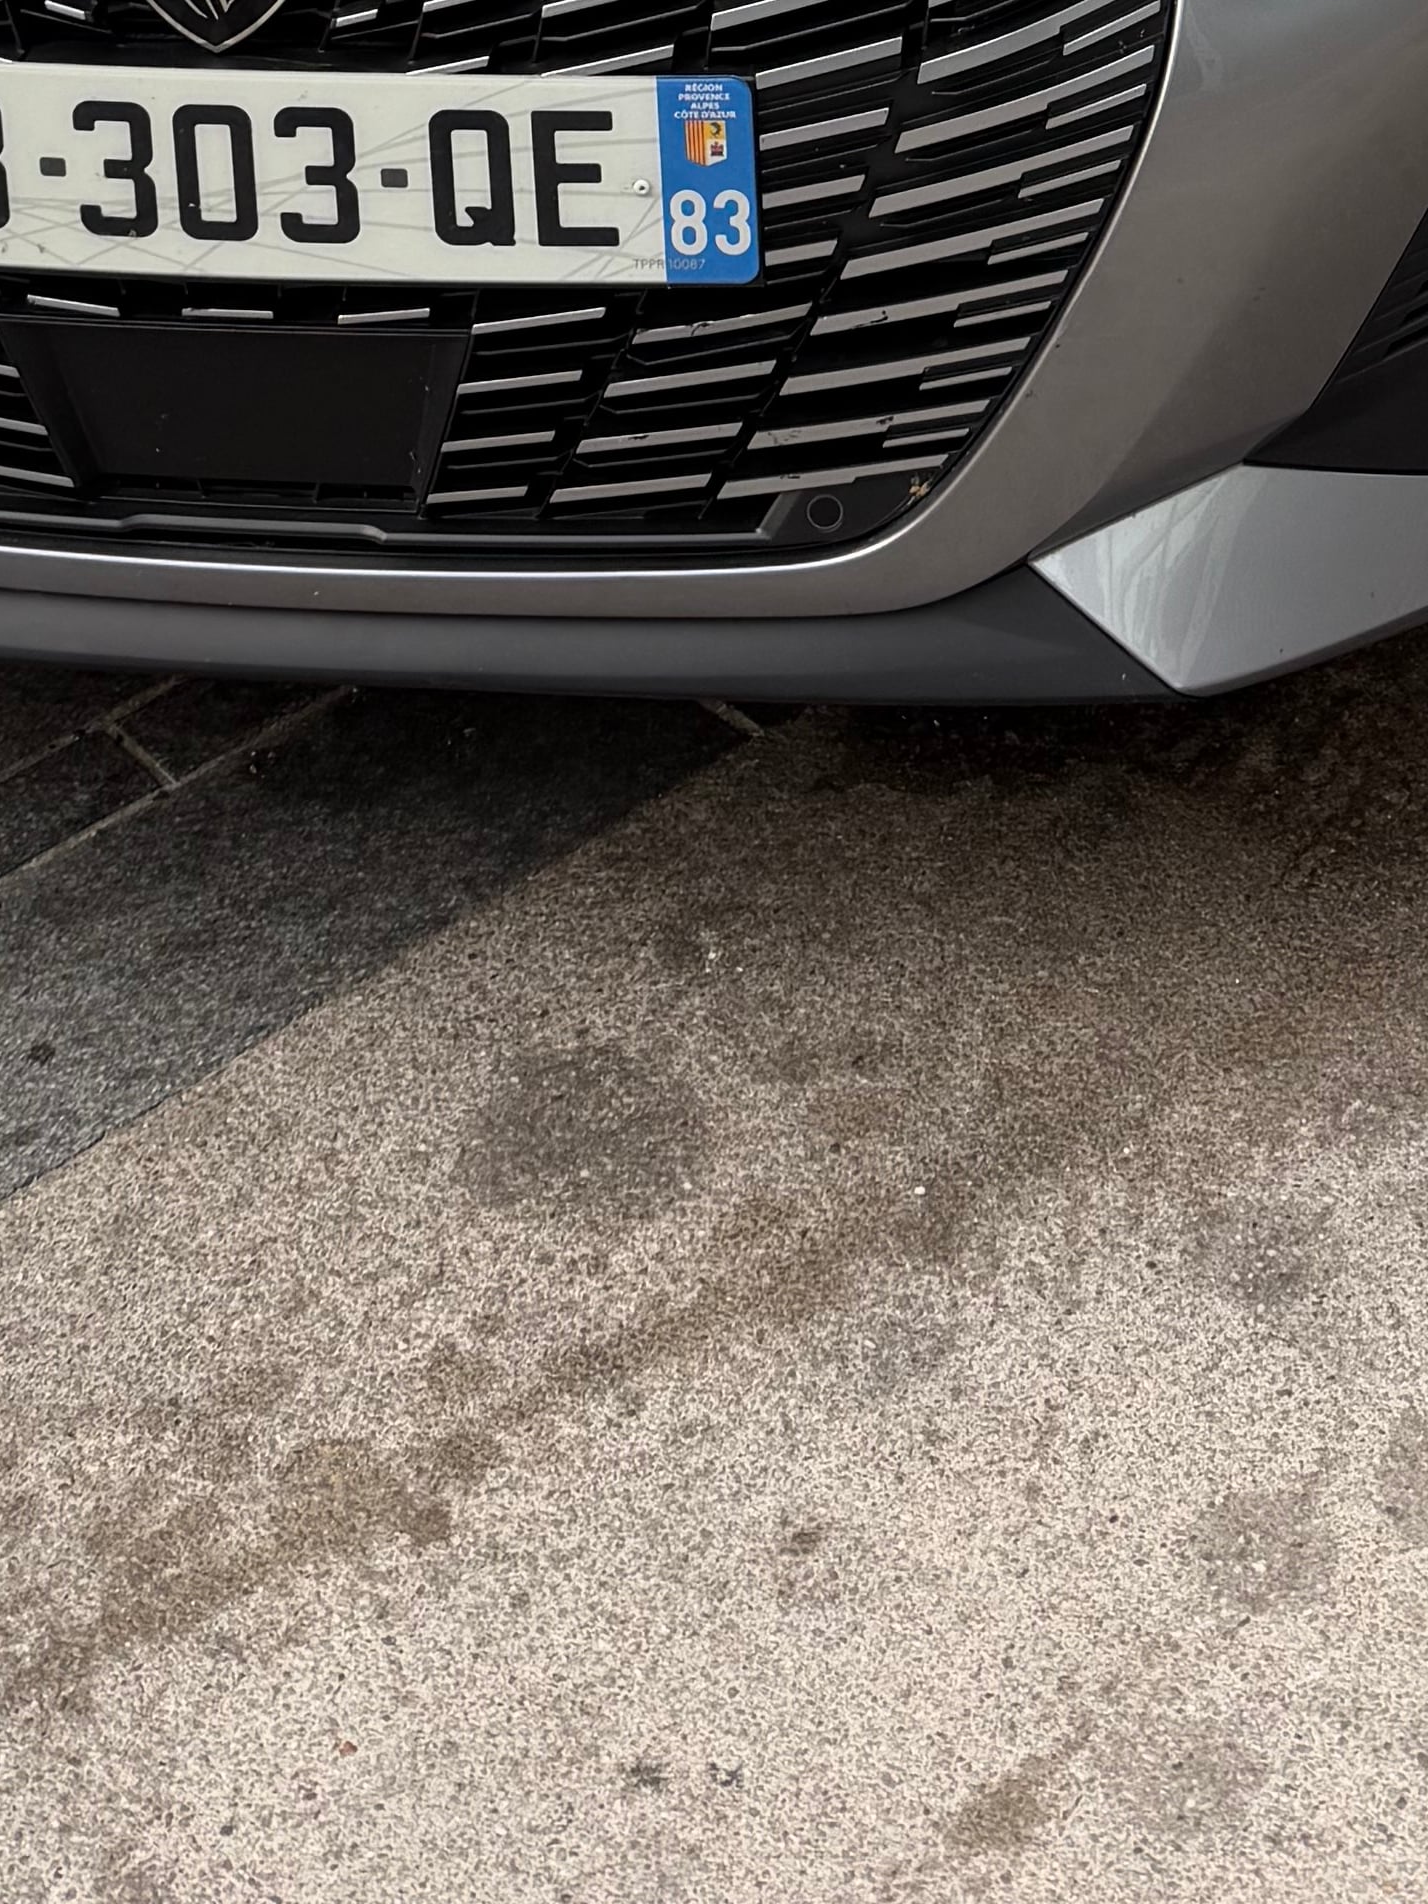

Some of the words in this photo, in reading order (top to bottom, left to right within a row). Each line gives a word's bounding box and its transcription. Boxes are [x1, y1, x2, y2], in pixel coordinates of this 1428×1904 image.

[684, 82, 723, 92] RÉGION
[678, 93, 730, 101] PROVENCE
[690, 102, 720, 110] ALPES
[674, 109, 699, 119] CÔTE
[701, 110, 737, 119] D'AZUR
[669, 189, 752, 256] 83
